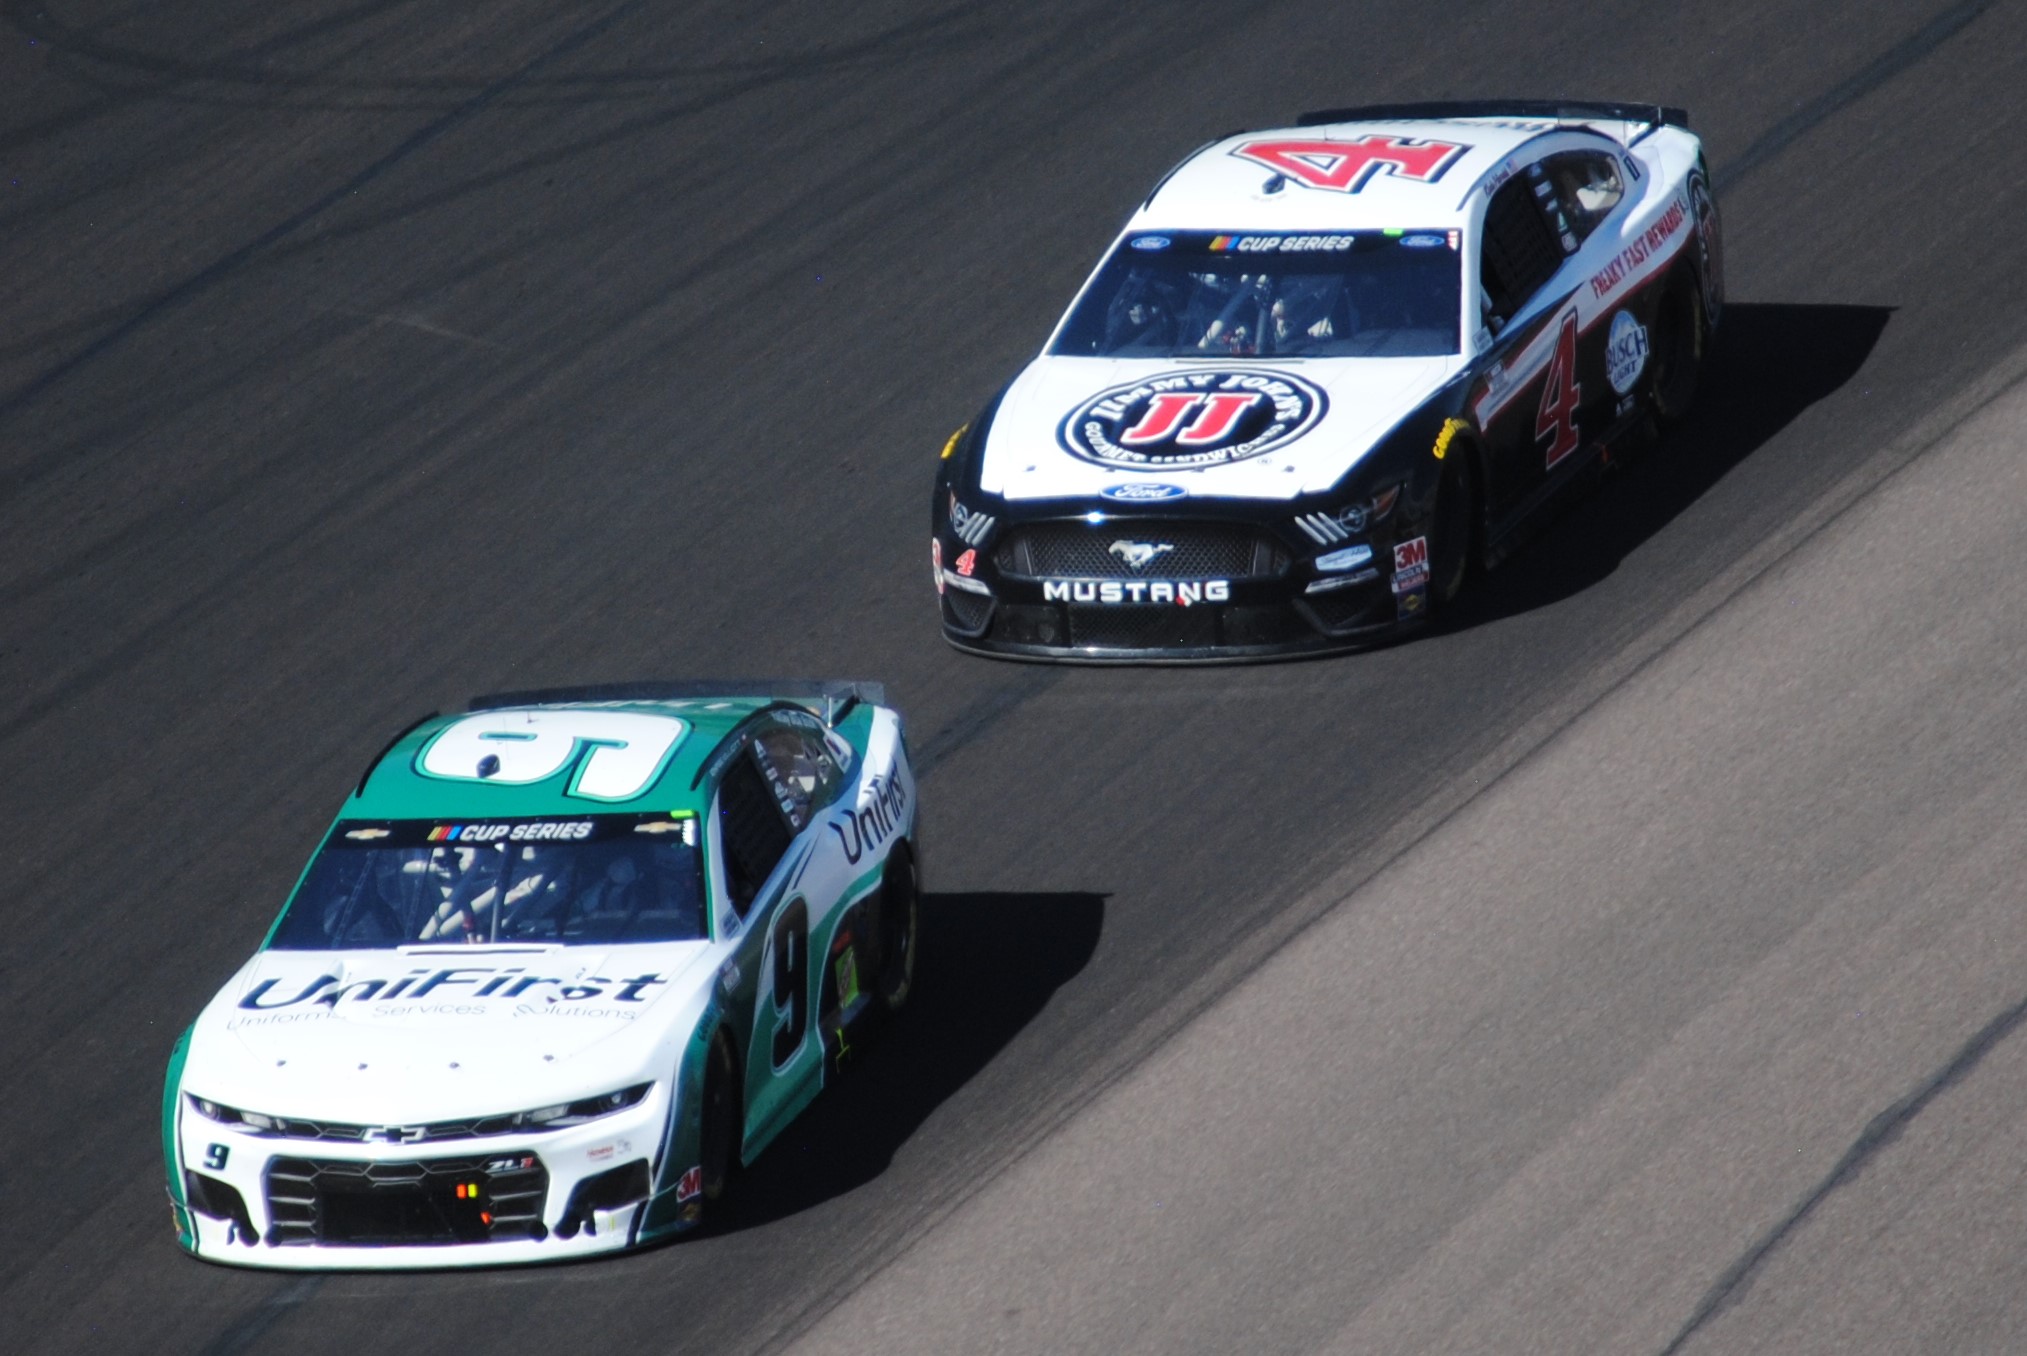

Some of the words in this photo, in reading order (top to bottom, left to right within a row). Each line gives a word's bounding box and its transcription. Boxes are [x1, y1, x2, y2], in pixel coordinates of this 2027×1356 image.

[1228, 134, 1474, 194] 4
[1238, 237, 1280, 250] CUP
[1280, 236, 1354, 250] SERIES
[1590, 254, 1626, 299] FREAKY
[1622, 235, 1649, 271] FAST
[1606, 326, 1649, 376] BUSCH
[1535, 306, 1580, 470] 4
[1614, 360, 1637, 385] LIGHT
[1089, 374, 1215, 420] JIMMY
[1120, 392, 1262, 444] JJ
[1084, 421, 1148, 463] GOURMET
[1112, 483, 1174, 498] Ford
[956, 549, 976, 576] 4
[1397, 539, 1426, 569] 3M
[1044, 580, 1229, 602] MUSTANG
[412, 709, 693, 803] 9
[460, 825, 510, 841] CUP
[510, 822, 593, 840] SERIES
[237, 967, 667, 1010] UniFirst
[771, 892, 809, 1076] 9
[374, 1004, 487, 1017] Services
[203, 1143, 230, 1171] 9
[485, 1157, 534, 1173] ZL1
[679, 1167, 701, 1199] 3M
